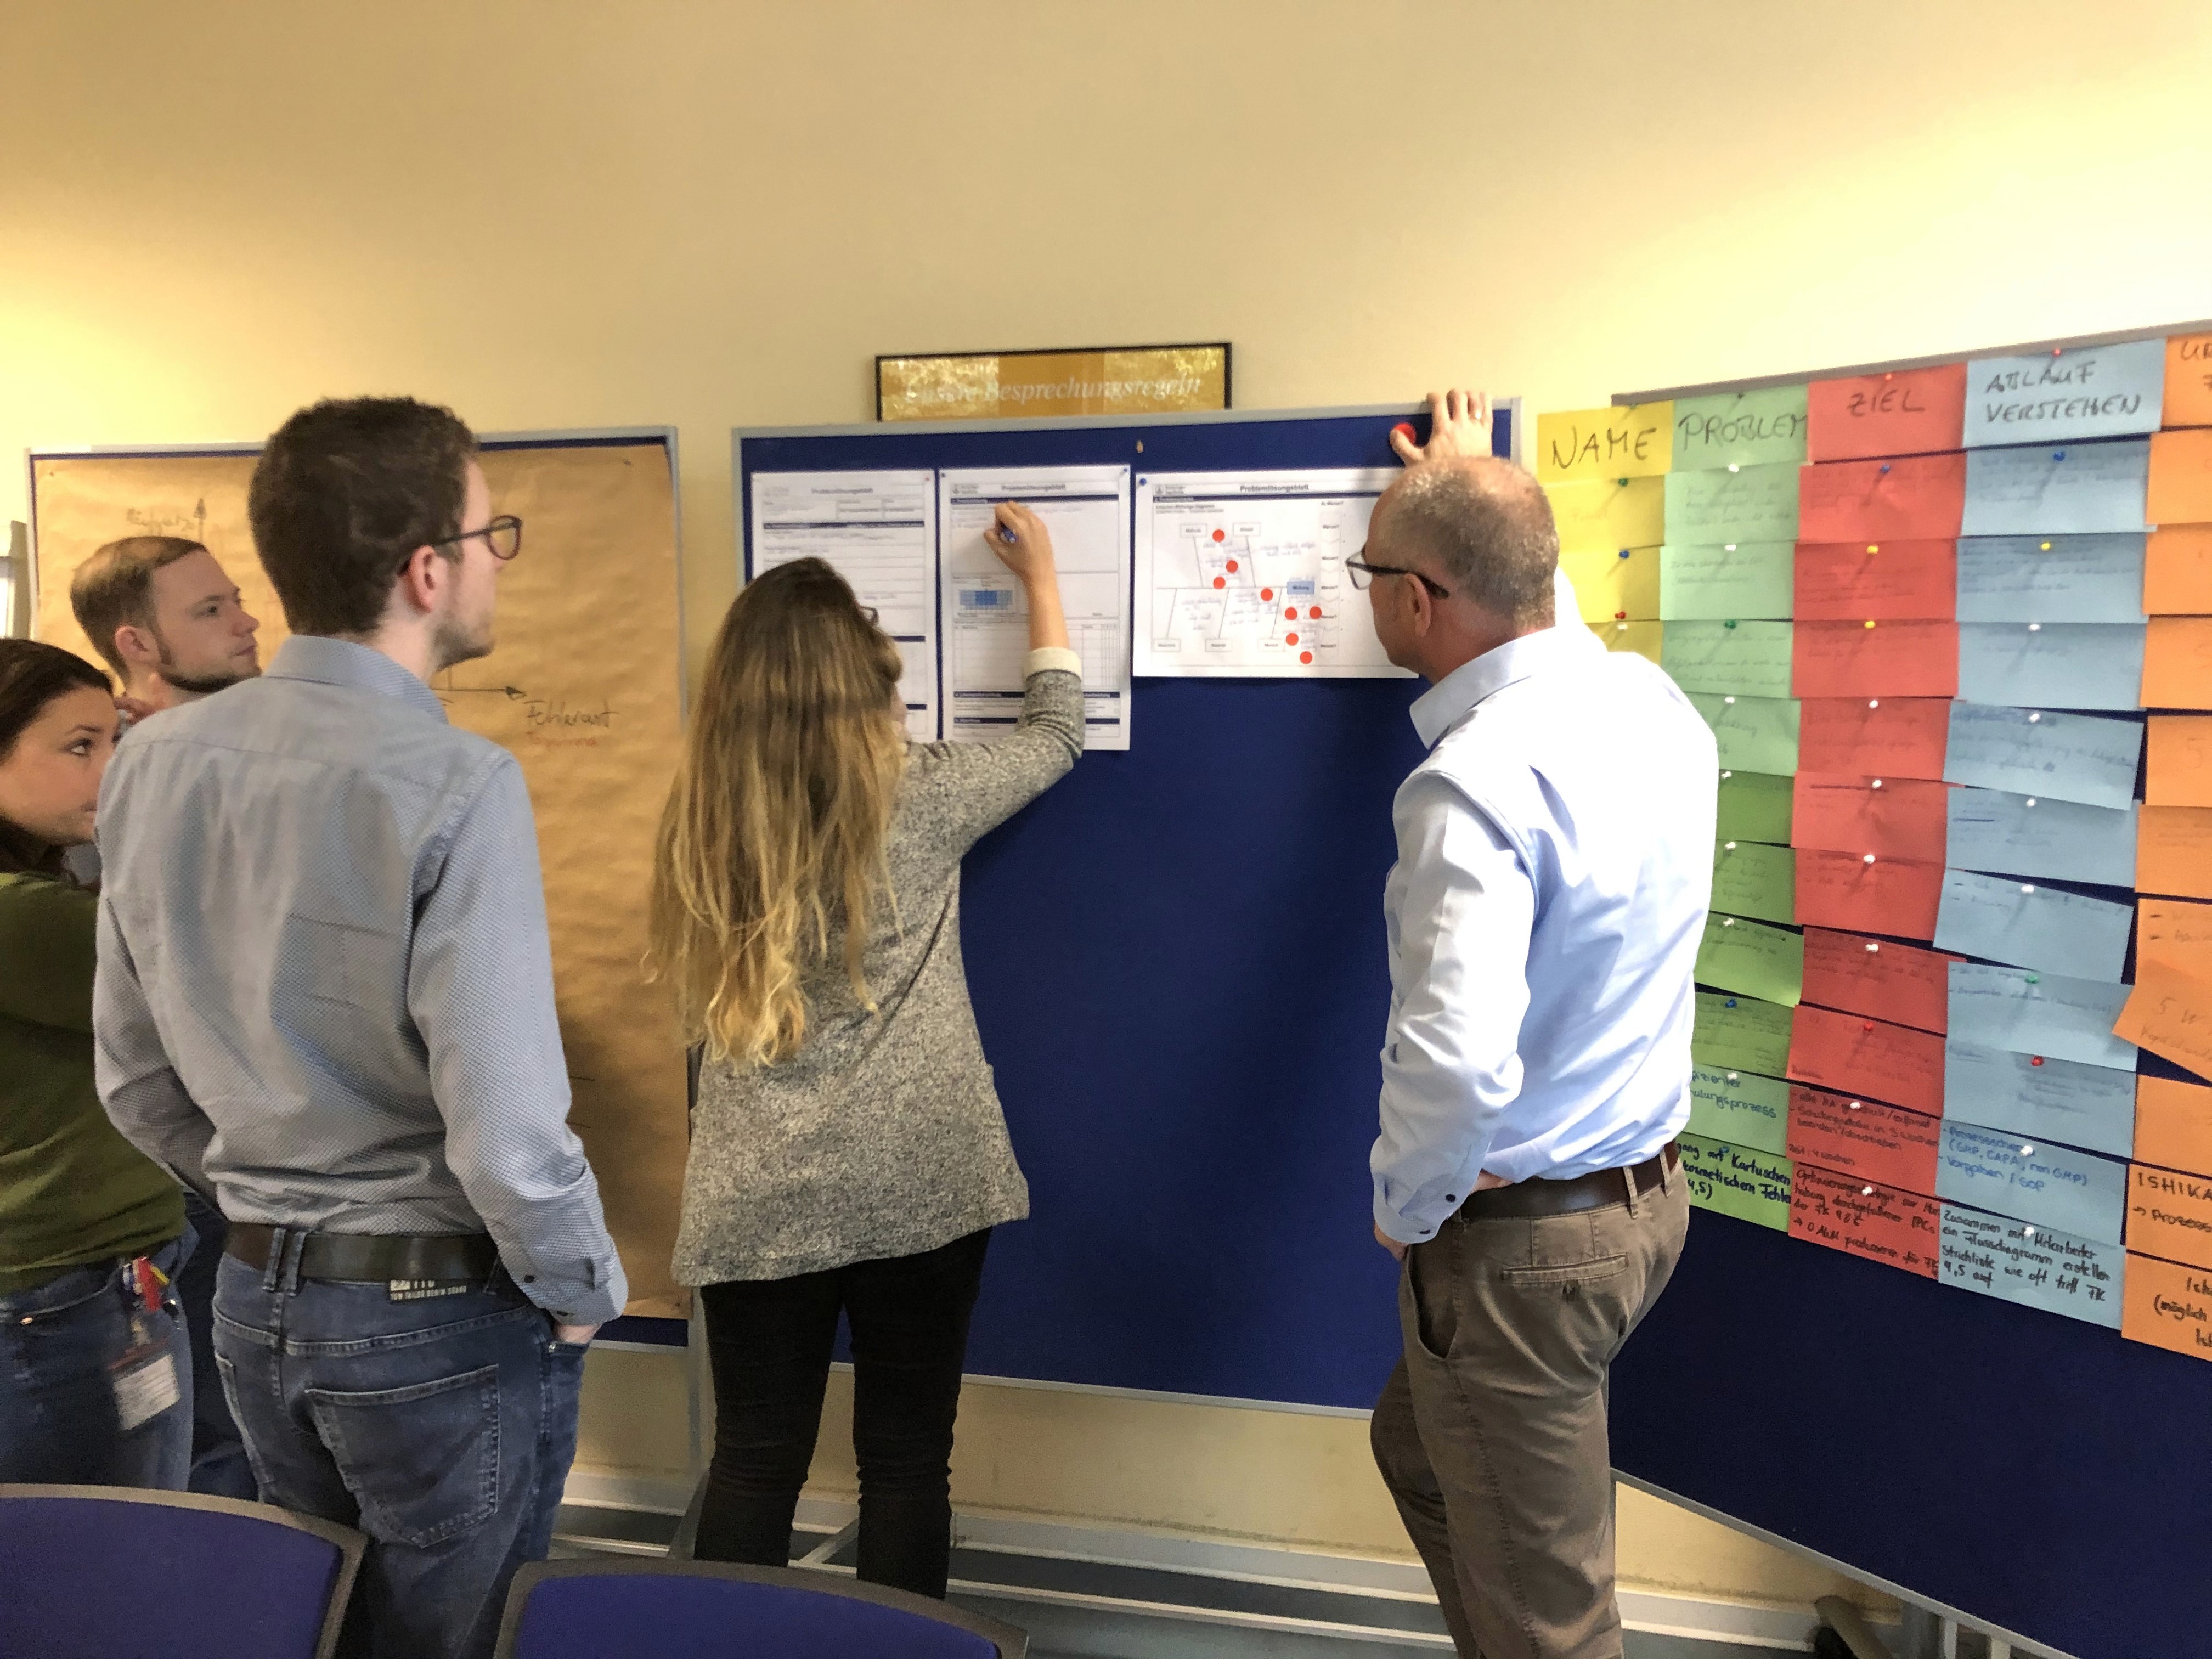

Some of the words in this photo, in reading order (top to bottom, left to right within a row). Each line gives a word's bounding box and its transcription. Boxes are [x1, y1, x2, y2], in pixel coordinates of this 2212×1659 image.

[1847, 388, 1925, 416] ZIEL
[1986, 394, 2141, 422] VERSTEHEN
[1552, 425, 1657, 470] NAME
[1678, 413, 1809, 451] PROBLEM
